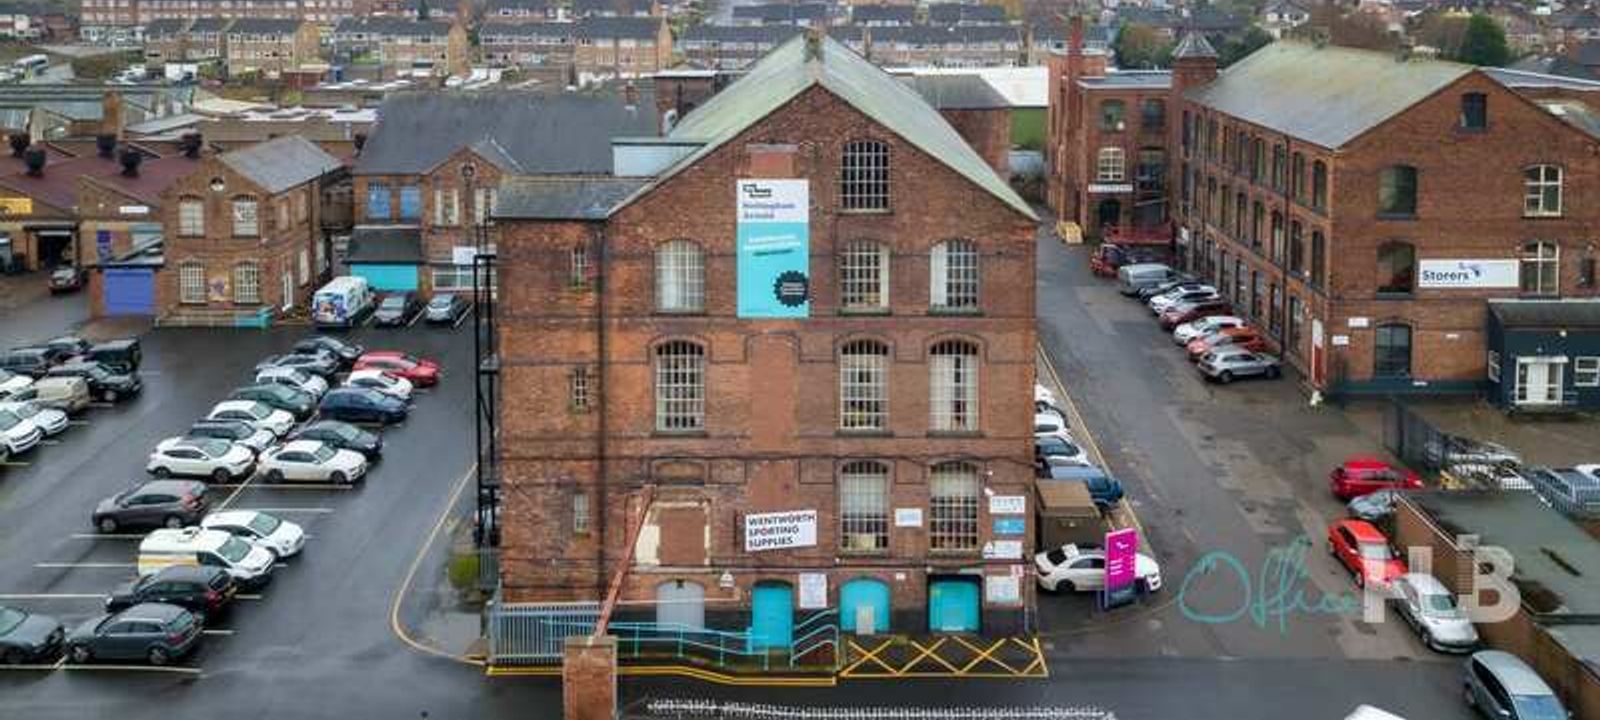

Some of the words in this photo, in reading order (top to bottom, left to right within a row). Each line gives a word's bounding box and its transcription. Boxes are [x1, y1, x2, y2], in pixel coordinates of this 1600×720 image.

[749, 514, 815, 526] WENTWORTH
[749, 525, 799, 536] SPORTING
[749, 537, 794, 548] SUPPLIES
